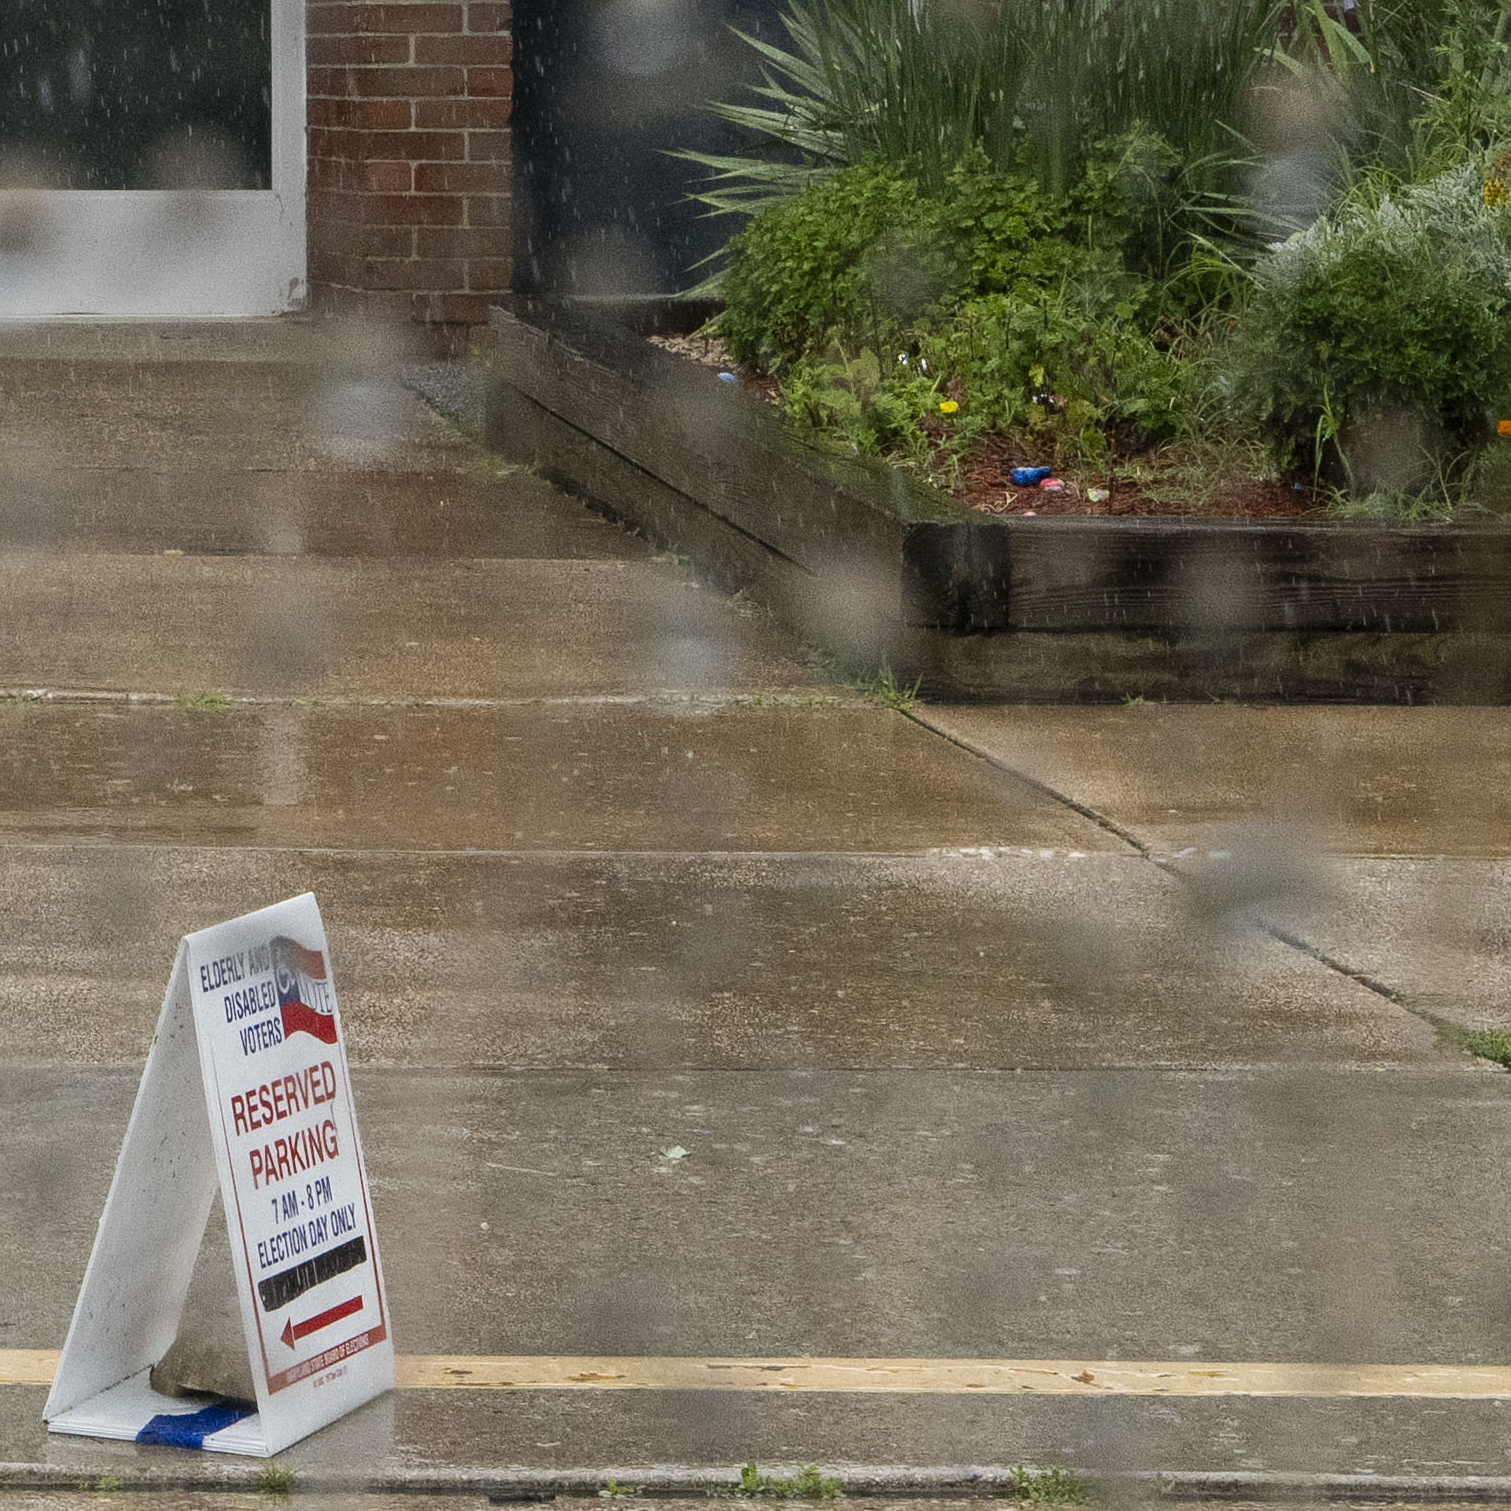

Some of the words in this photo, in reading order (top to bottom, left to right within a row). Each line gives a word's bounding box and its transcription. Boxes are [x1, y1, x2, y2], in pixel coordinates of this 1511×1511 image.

[200, 951, 245, 993] ELDERLY
[248, 945, 270, 977] AND
[223, 981, 276, 1023] DISABLED
[239, 1016, 283, 1056] VOTERS
[231, 1061, 337, 1137] RESERVED
[249, 1119, 339, 1190] PARKING
[271, 1197, 279, 1224] 7
[282, 1190, 299, 1221] AM
[306, 1183, 315, 1210] 8
[315, 1175, 333, 1207] PM
[257, 1223, 309, 1269] ELECTION
[308, 1214, 329, 1248] DAY
[330, 1202, 357, 1237] ONLY
